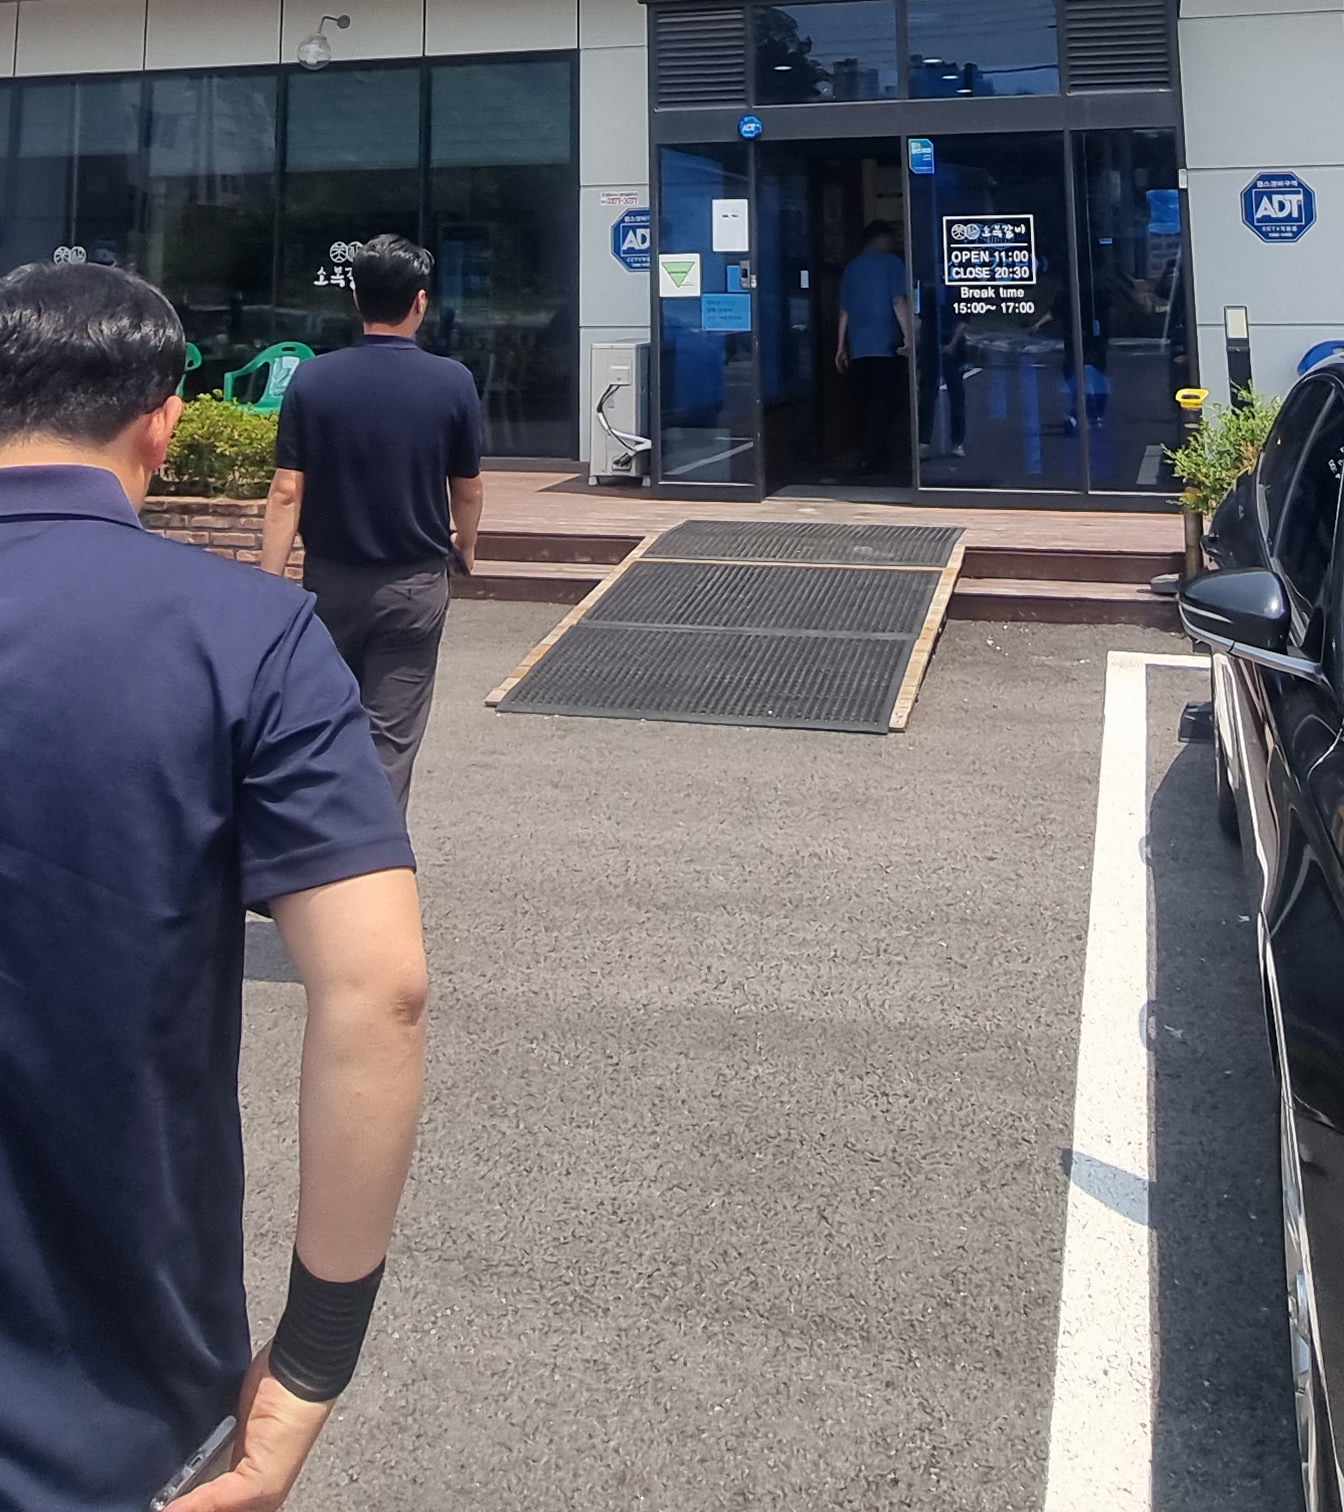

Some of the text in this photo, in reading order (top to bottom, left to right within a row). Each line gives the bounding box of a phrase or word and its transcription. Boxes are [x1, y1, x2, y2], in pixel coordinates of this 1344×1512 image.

[1254, 194, 1303, 219] ADT
[620, 228, 650, 250] AD
[951, 250, 1029, 263] OPEN 11:00
[951, 266, 1030, 279] CLOSE 20:30
[960, 287, 1025, 299] Break time
[1000, 302, 1035, 315] 17:00
